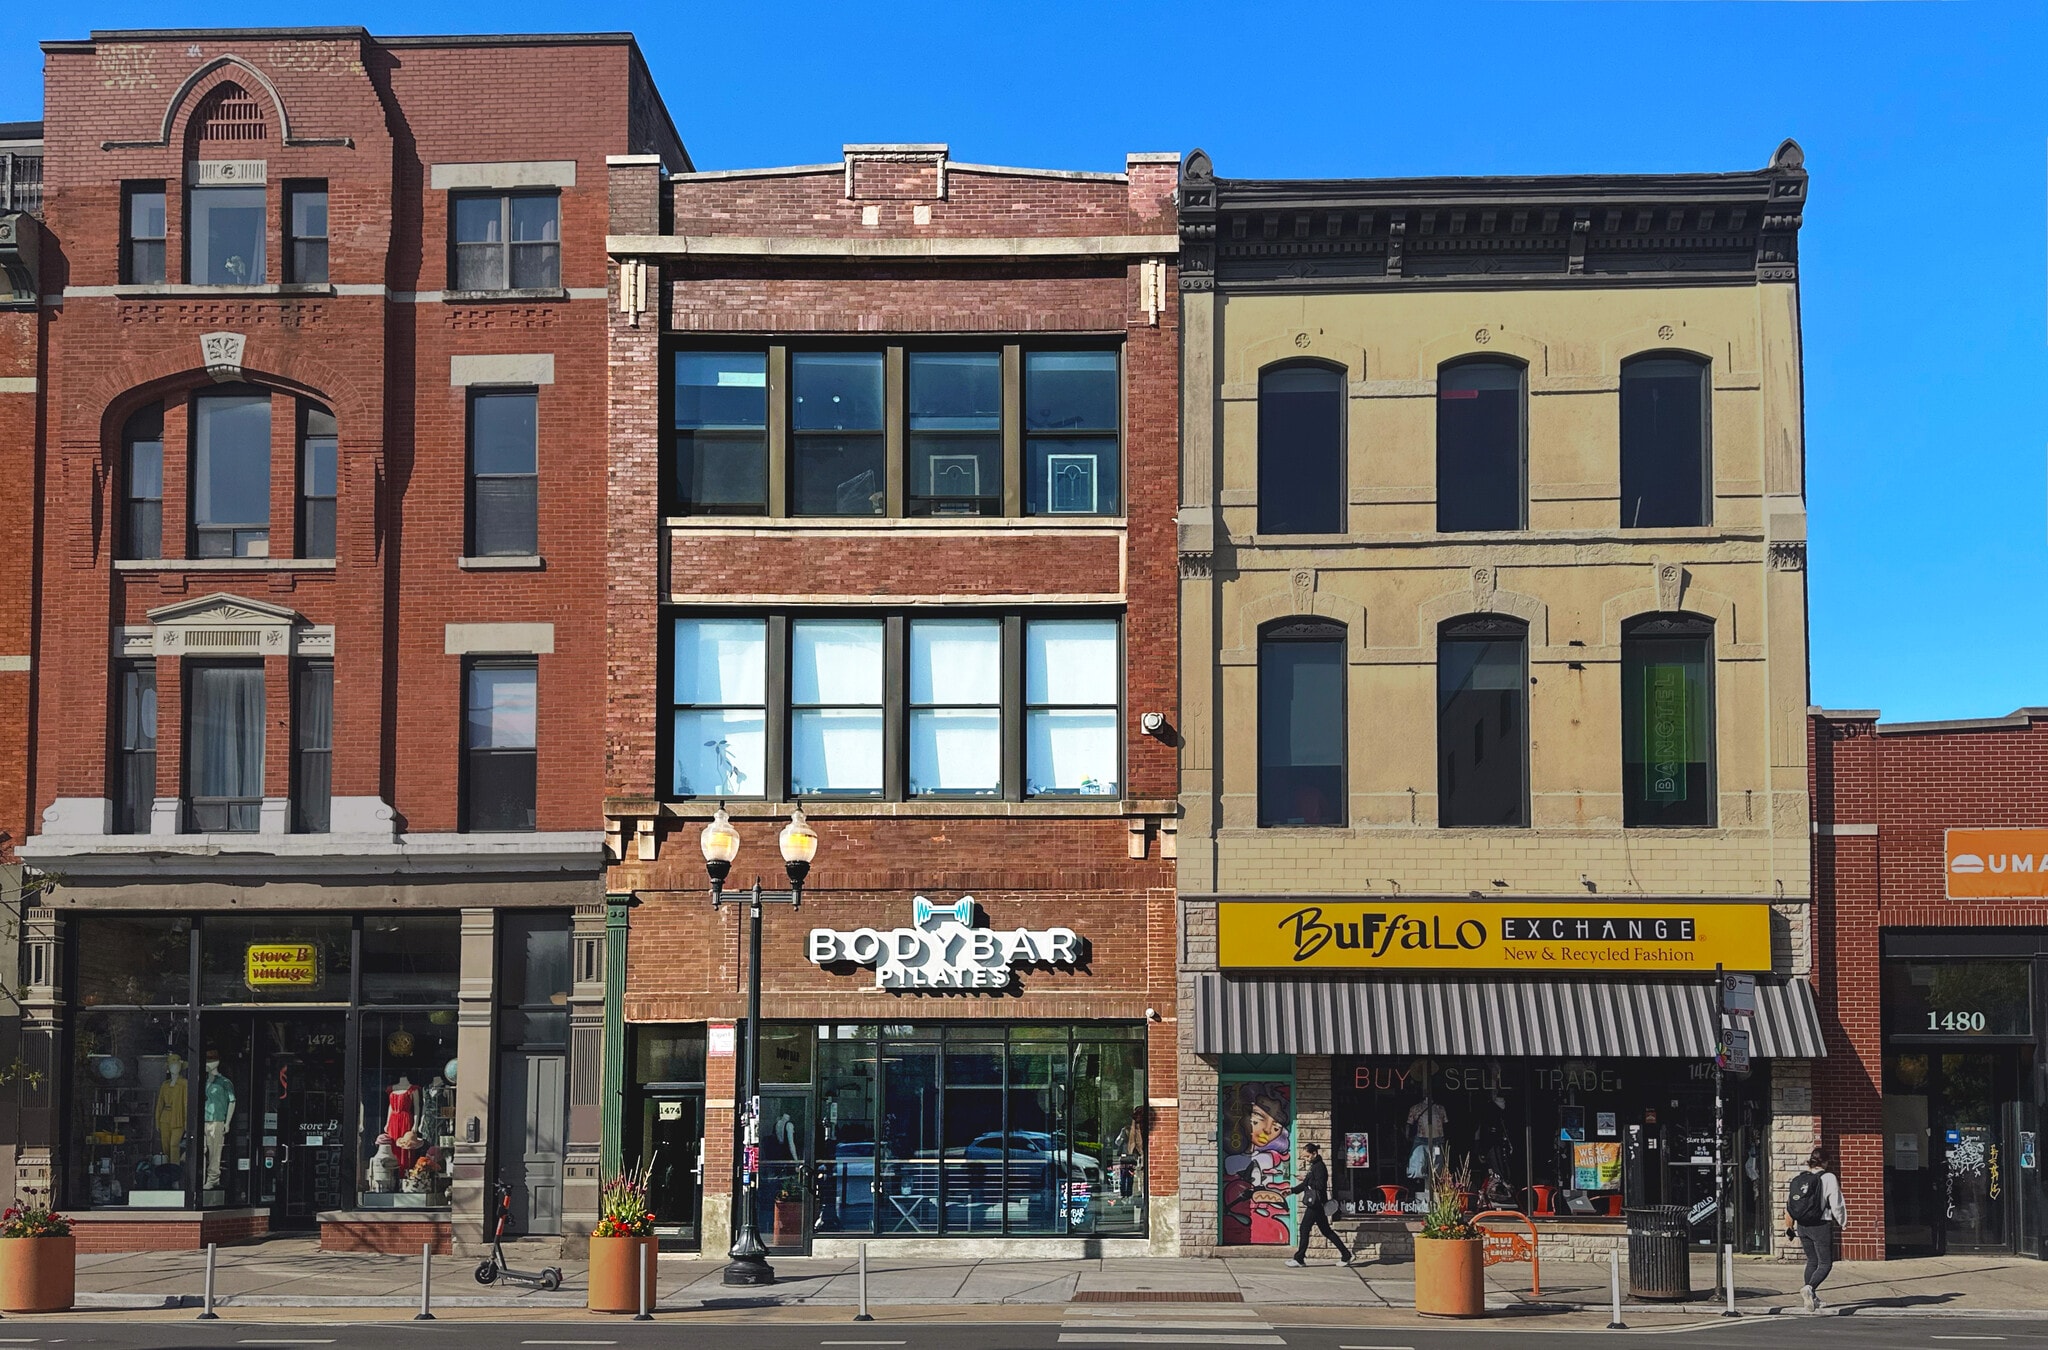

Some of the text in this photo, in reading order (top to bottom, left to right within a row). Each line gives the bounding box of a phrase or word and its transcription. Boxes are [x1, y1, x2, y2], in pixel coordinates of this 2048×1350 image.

[1655, 673, 1675, 792] BANGTEL
[1504, 920, 1692, 939] EXCHANGE
[811, 928, 1076, 962] BODYBAR
[252, 948, 309, 963] store B
[1504, 947, 1695, 963] New & Recycled Fashion
[253, 964, 310, 981] vintage
[879, 967, 1010, 986] PILATES
[1927, 1011, 1986, 1031] 1480
[308, 1035, 335, 1045] 1472
[1355, 1067, 1411, 1090] BUY
[1445, 1068, 1512, 1090] SELL
[1535, 1069, 1614, 1091] TRADE
[660, 1106, 681, 1114] 1474
[299, 1119, 338, 1131] store B
[1579, 1146, 1605, 1157] WE'RE
[1358, 1200, 1365, 1211] &
[1367, 1200, 1398, 1214] Recycled
